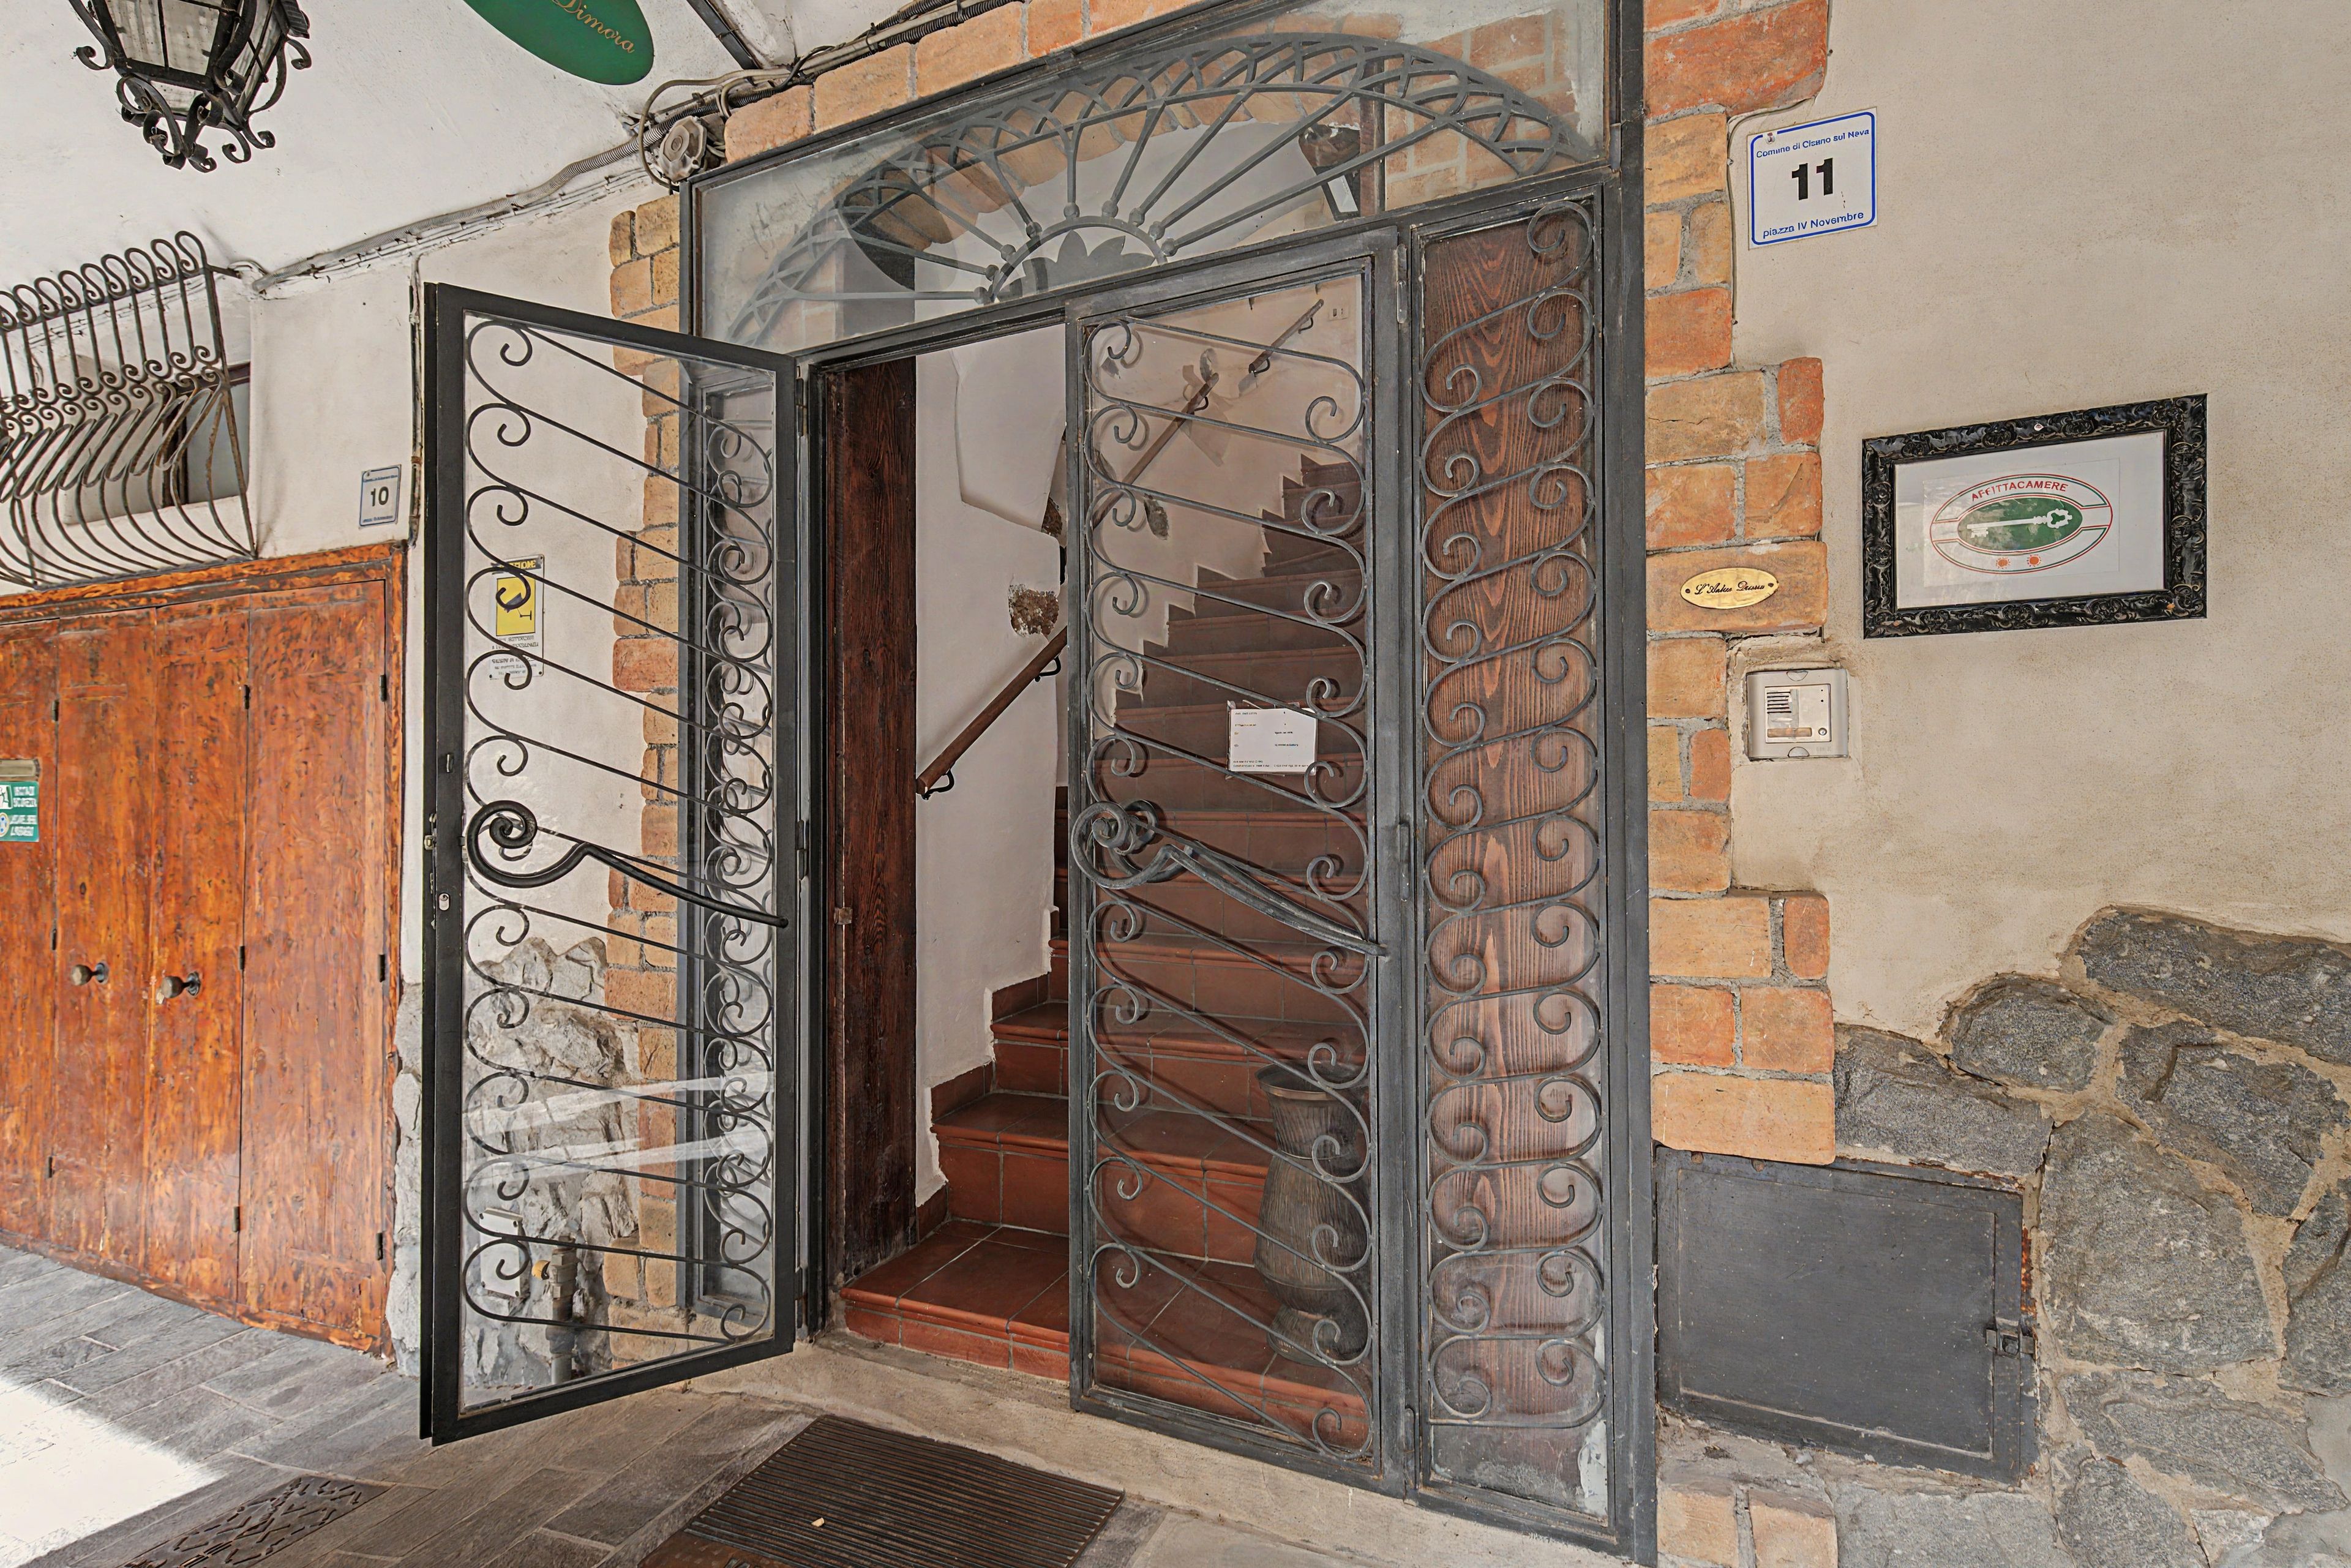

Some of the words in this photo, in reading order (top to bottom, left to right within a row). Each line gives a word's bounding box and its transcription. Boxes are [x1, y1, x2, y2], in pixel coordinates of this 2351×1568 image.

[1756, 146, 1790, 158] Comune
[1802, 137, 1831, 148] Cisano
[1833, 133, 1846, 141] sul
[1848, 129, 1869, 138] Neva
[1791, 157, 1834, 201] 11
[1763, 225, 1794, 239] piazza
[1798, 221, 1807, 231] IV
[1811, 212, 1864, 228] Novembre
[370, 486, 389, 507] 10
[1971, 481, 2069, 501] AFFITTACAMERE
